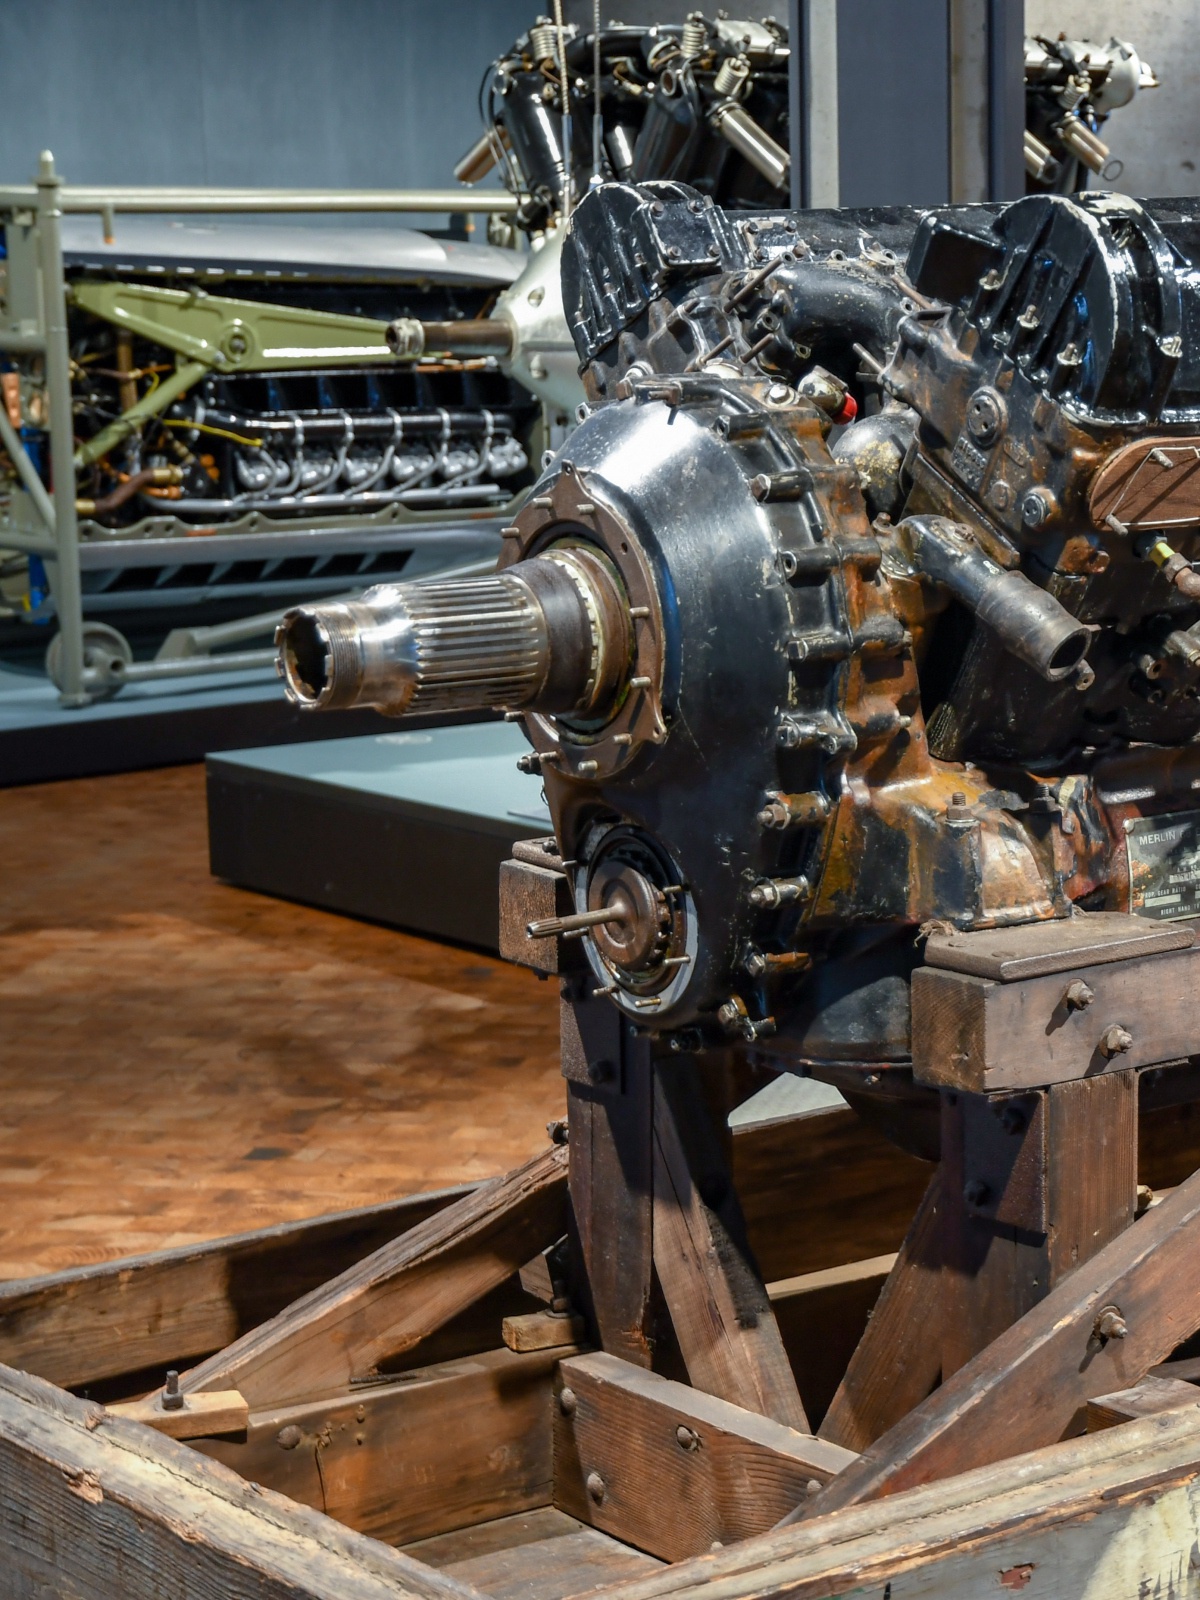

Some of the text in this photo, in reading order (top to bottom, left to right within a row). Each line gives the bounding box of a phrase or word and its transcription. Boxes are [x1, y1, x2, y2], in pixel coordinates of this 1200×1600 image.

[1139, 831, 1176, 845] MERLIN
[1142, 891, 1156, 899] ROP.
[1171, 886, 1186, 894] RATIO
[1160, 907, 1175, 915] RIGHT
[1178, 905, 1190, 913] HAND
